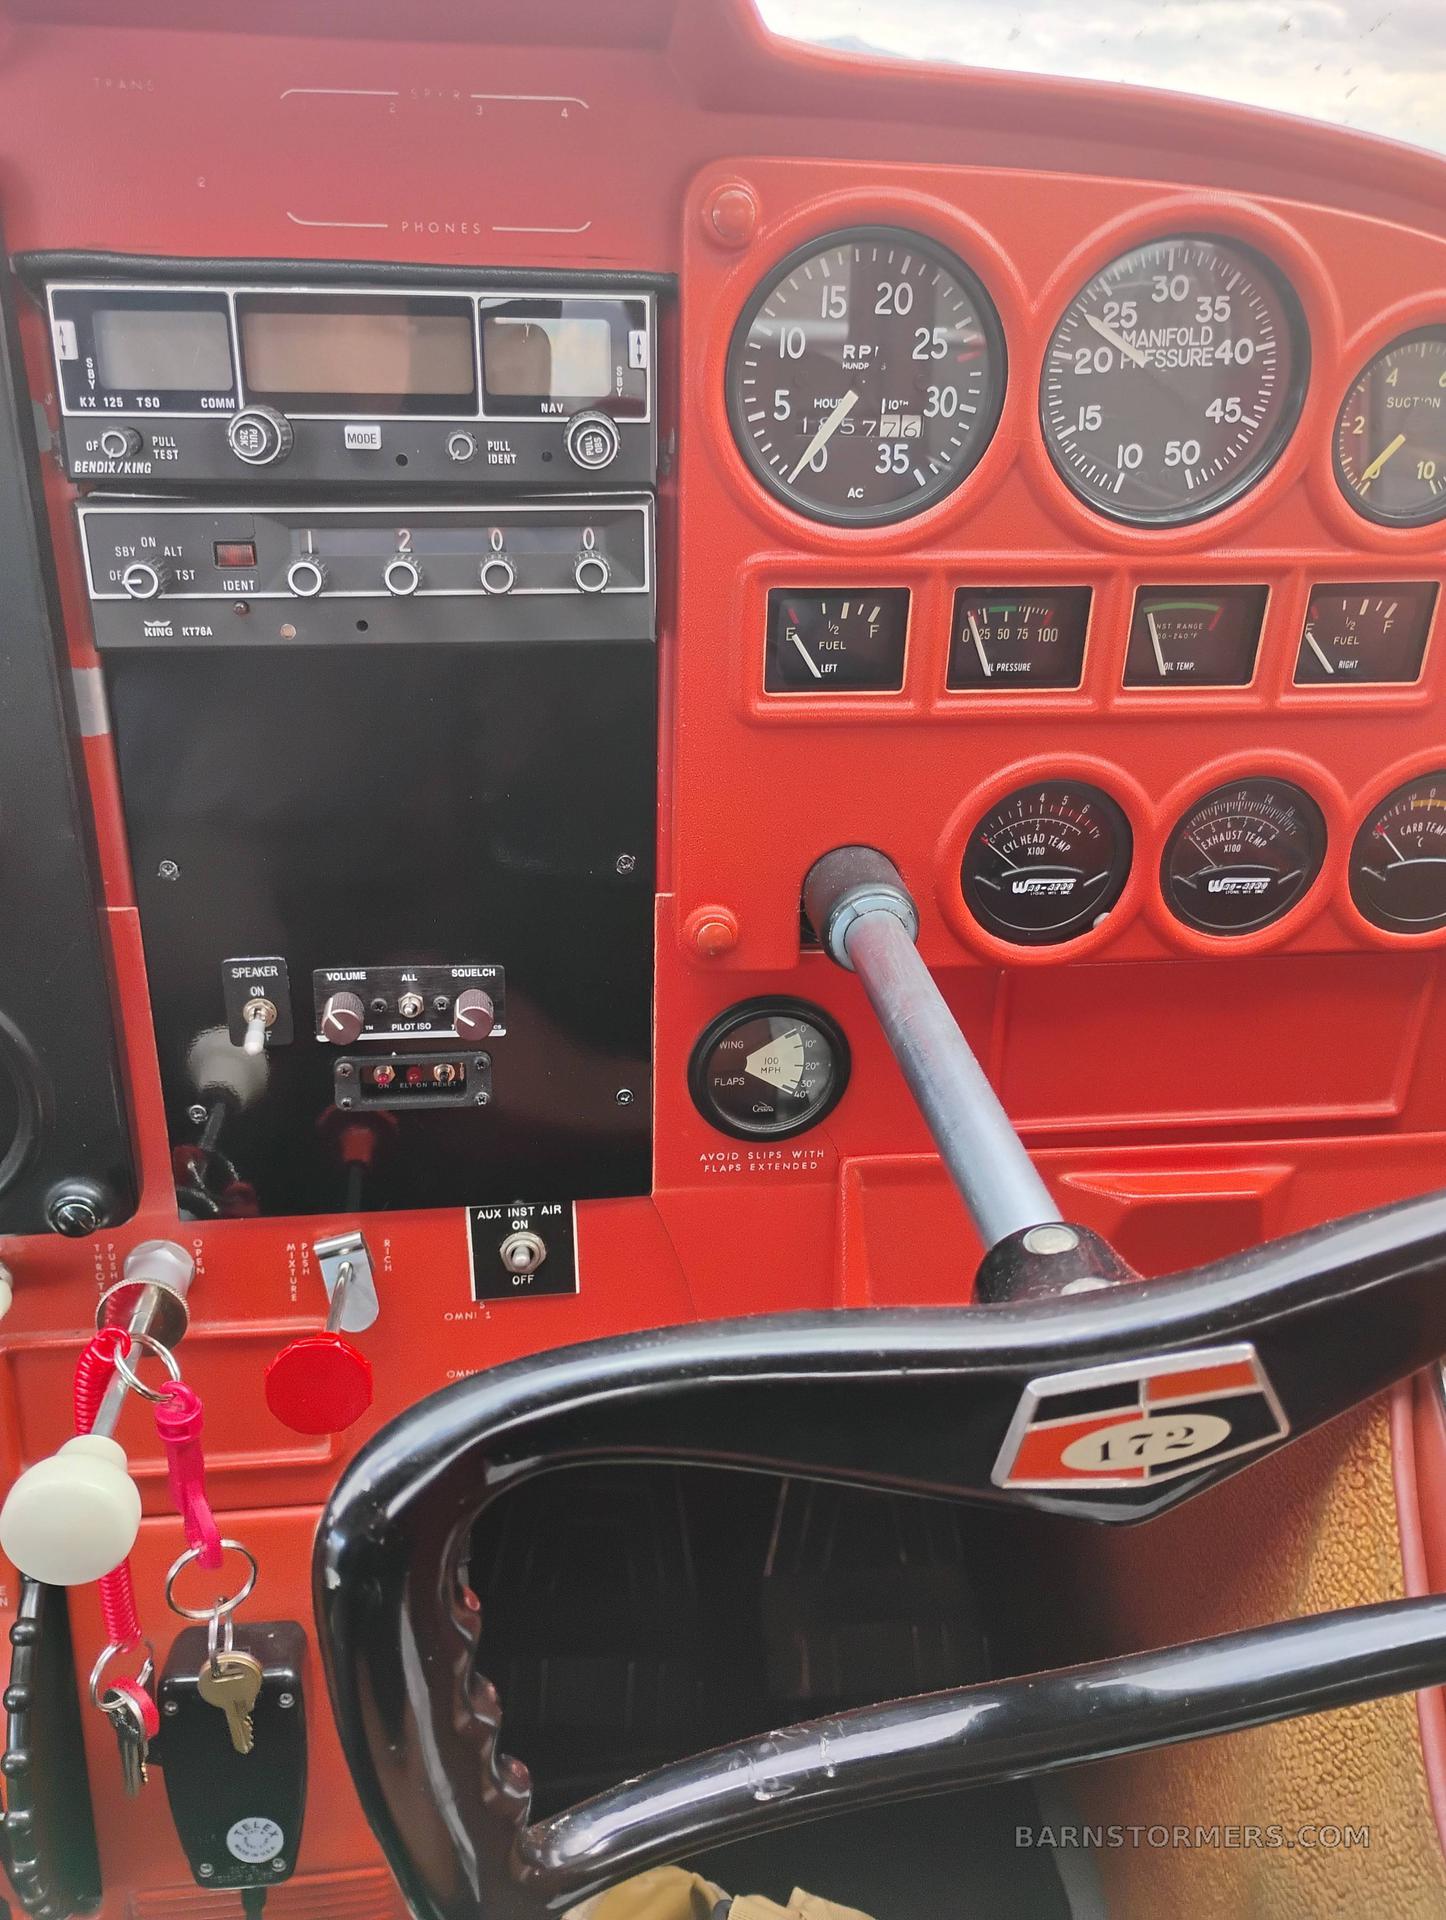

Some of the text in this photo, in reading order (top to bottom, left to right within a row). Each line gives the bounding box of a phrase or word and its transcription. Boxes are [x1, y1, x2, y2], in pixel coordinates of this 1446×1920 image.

[561, 107, 569, 119] 4
[401, 221, 481, 235] PHONES
[1151, 274, 1190, 302] 30
[821, 285, 848, 319] 15
[874, 282, 914, 316] 20
[1102, 301, 1138, 329] 25
[1195, 295, 1231, 322] 35
[779, 327, 806, 359] 10
[912, 327, 949, 360] 25
[1121, 326, 1213, 349] MANIFOLD
[1214, 338, 1254, 365] 40
[1074, 346, 1113, 375] 20
[86, 357, 96, 390] SBY
[1385, 367, 1399, 387] 4
[80, 397, 161, 408] KX 125 TSO
[200, 397, 236, 409] COMM
[540, 402, 565, 414] NAV
[773, 389, 791, 421] 5
[814, 398, 845, 409] HOU
[923, 386, 958, 418] 30
[1205, 397, 1242, 424] 45
[1078, 404, 1102, 431] 15
[1352, 415, 1365, 434] 2
[86, 440, 99, 451] OF
[152, 436, 176, 448] PULL
[347, 432, 378, 446] MODE
[487, 440, 511, 452] PULL
[154, 449, 178, 460] TEST
[488, 453, 517, 465] IDENT
[875, 443, 910, 474] 35
[1117, 439, 1201, 469] 10 50
[74, 461, 152, 474] BENDIX/KING
[1417, 461, 1436, 480] 10
[847, 487, 864, 499] AC
[141, 536, 156, 548] ON
[115, 546, 183, 557] SBY ALT
[109, 570, 196, 582] OF TST
[223, 580, 255, 591] IDENT
[144, 626, 174, 637] KING
[785, 626, 796, 641] E
[869, 624, 880, 639] F
[1383, 620, 1394, 634] F
[962, 627, 1059, 643] 0 25 50 75 100
[1333, 636, 1360, 646] FUEL
[818, 641, 847, 650] FUEL
[820, 663, 838, 673] LEFT
[987, 662, 1032, 672] IL PRESSURE
[1164, 661, 1196, 671] OIL TEMP.
[1338, 660, 1359, 669] RIGHT
[1039, 792, 1090, 814] 4 5 6
[1237, 791, 1247, 800] 12
[1264, 793, 1274, 804] 14
[1400, 822, 1424, 836] CARB
[1002, 833, 1072, 854] CYL HEAD TEMP
[1201, 830, 1268, 850] EXHAUST TEMP
[1027, 847, 1045, 856] X100
[1223, 844, 1242, 853] X100
[231, 965, 279, 979] SPEAKER
[326, 971, 367, 982] VOLUME
[401, 973, 418, 982] ALL
[451, 967, 496, 978] SQUELCH
[250, 986, 265, 997] ON
[391, 1022, 432, 1031] PILOT ISO
[719, 1040, 744, 1049] WING
[764, 1057, 779, 1065] 100
[760, 1066, 781, 1074] MPH
[416, 1081, 428, 1089] ON
[714, 1077, 745, 1086] FLAPS
[700, 1150, 825, 1161] AVOID SLIPS WITH
[704, 1161, 818, 1173] FLAPS EXTENDED
[477, 1204, 562, 1220] AUX INST AIR
[511, 1219, 529, 1230] ON
[107, 1243, 119, 1279] PUSH
[193, 1239, 205, 1275] OPEN
[301, 1242, 310, 1276] PUSH
[384, 1239, 393, 1272] RICH
[93, 1243, 106, 1297] THROT
[286, 1243, 298, 1302] MIXTURE
[512, 1274, 535, 1286] OFF
[1099, 1426, 1195, 1462] 172
[233, 1820, 279, 1837] TELEX
